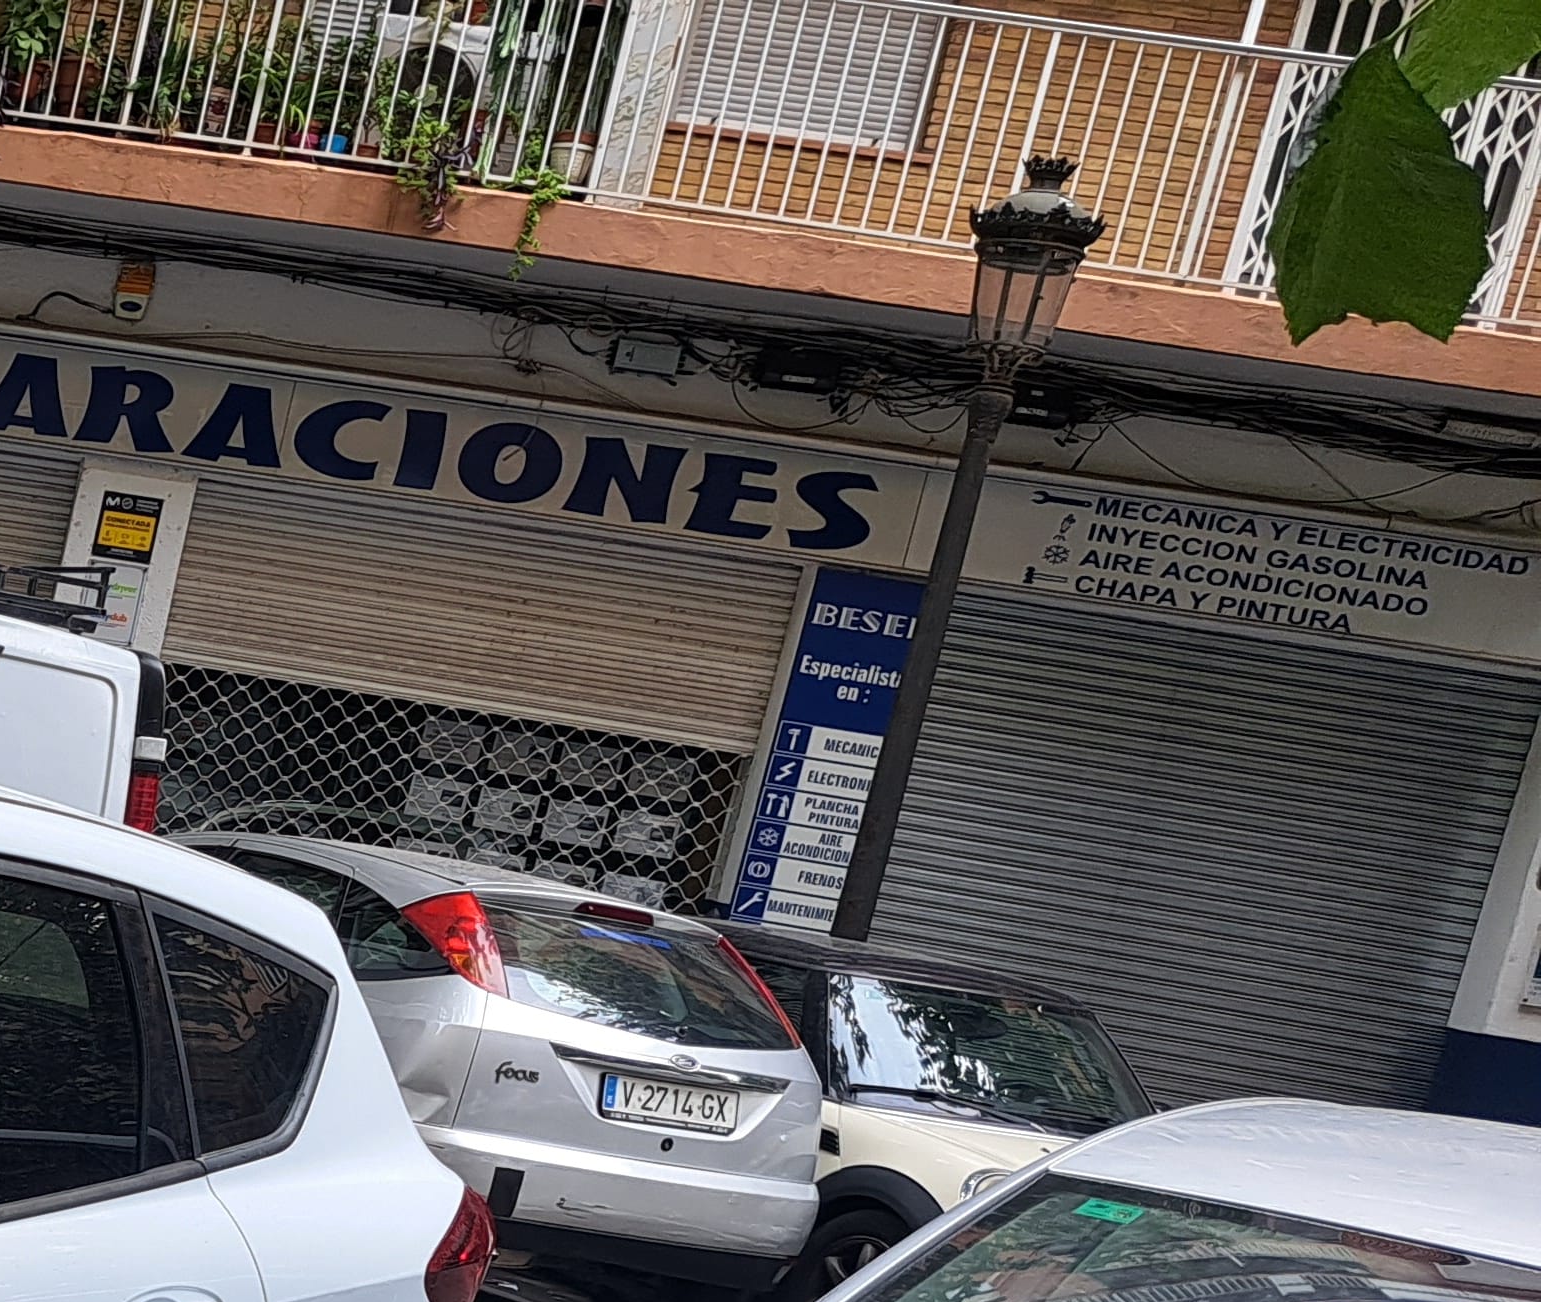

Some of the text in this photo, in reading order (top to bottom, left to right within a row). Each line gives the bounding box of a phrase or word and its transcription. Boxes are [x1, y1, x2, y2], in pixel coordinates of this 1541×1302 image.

[1095, 498, 1530, 577] MECANICA Y ELECTRICIDAD
[1087, 523, 1428, 590] INYECCION GASOLINA
[1079, 549, 1428, 617] AIRE ACONDICIONADO
[1074, 575, 1352, 634] CHAPA Y PINTURA
[799, 654, 901, 689] Especialist
[836, 685, 859, 702] en
[824, 738, 880, 760] MECANIC
[807, 770, 873, 792] ELECTRONI
[805, 797, 859, 816] PLANCHA
[808, 812, 859, 830] PINTURA
[818, 833, 843, 848] AIRE
[783, 842, 851, 864] ACONDICION
[797, 870, 844, 890] FRENOS
[767, 899, 835, 922] MANTENIMIE
